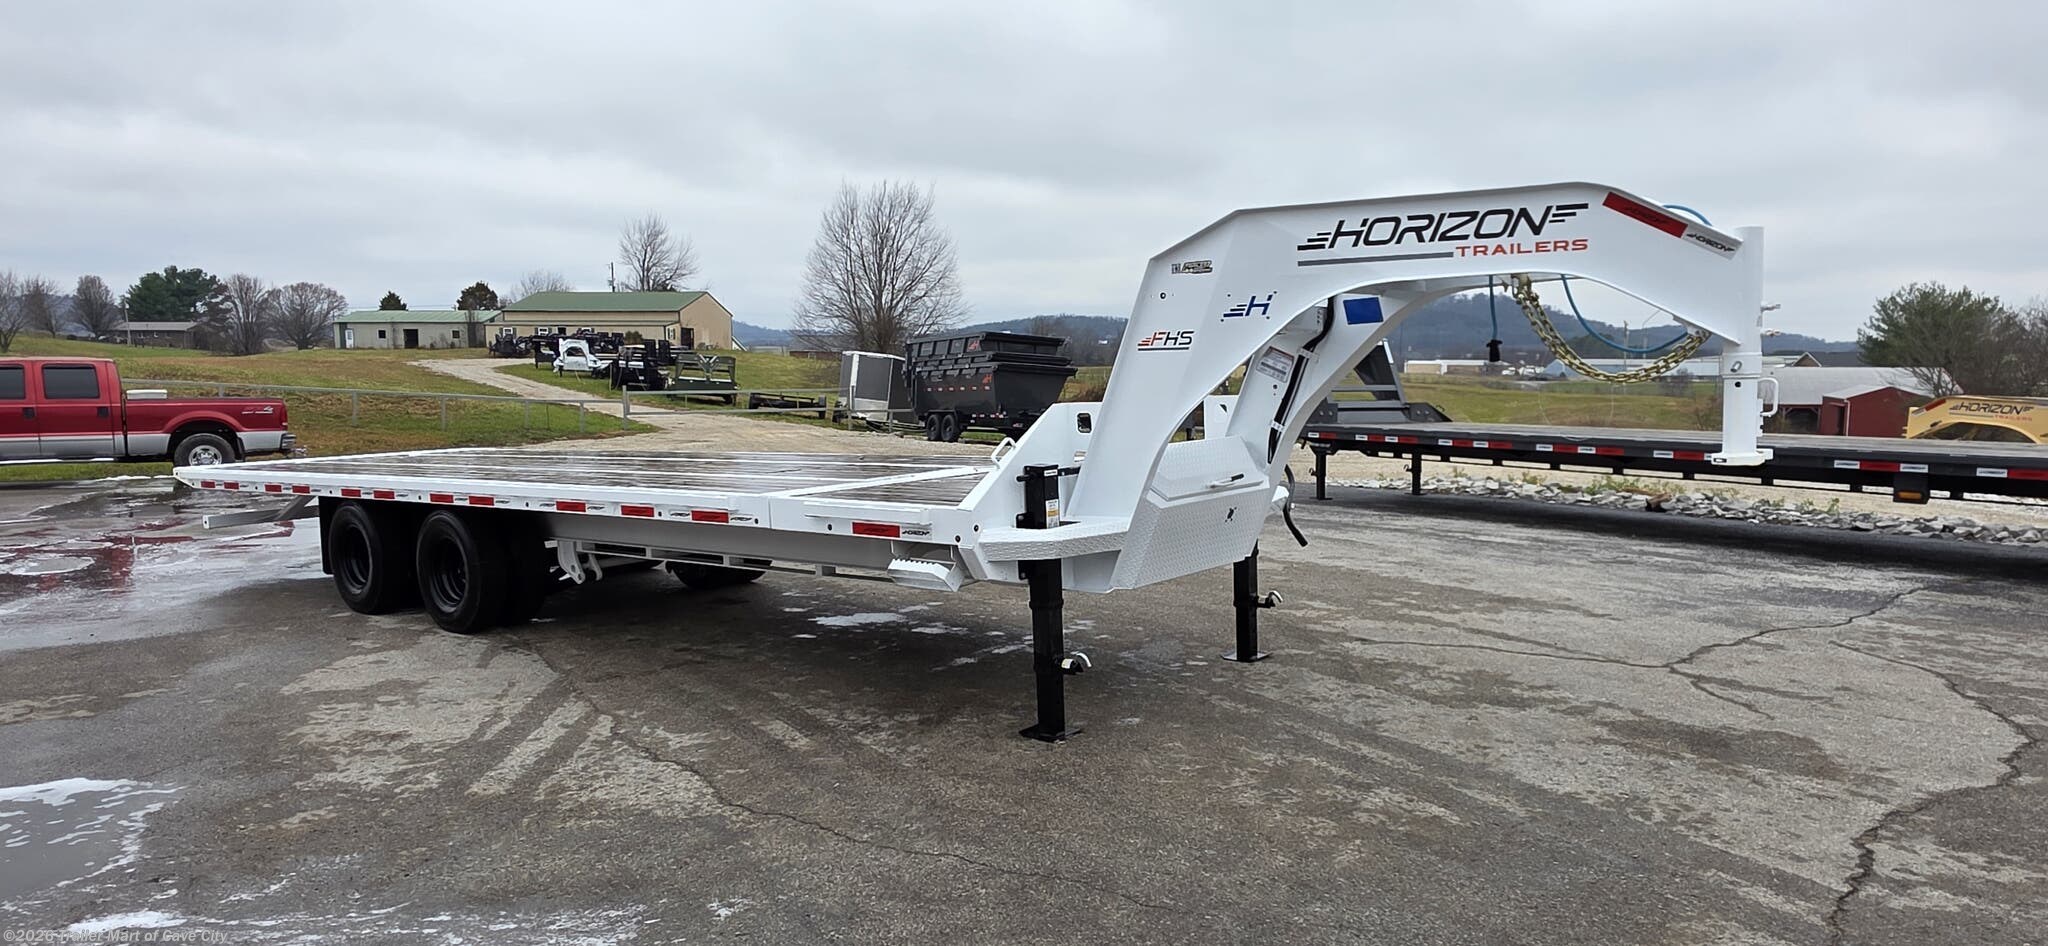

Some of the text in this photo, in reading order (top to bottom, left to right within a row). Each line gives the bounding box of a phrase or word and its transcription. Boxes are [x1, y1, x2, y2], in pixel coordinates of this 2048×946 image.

[1328, 205, 1554, 249] HORIZON
[1455, 239, 1589, 258] TRAILERS
[1150, 330, 1195, 347] FHS
[1959, 401, 2025, 415] HORIZON
